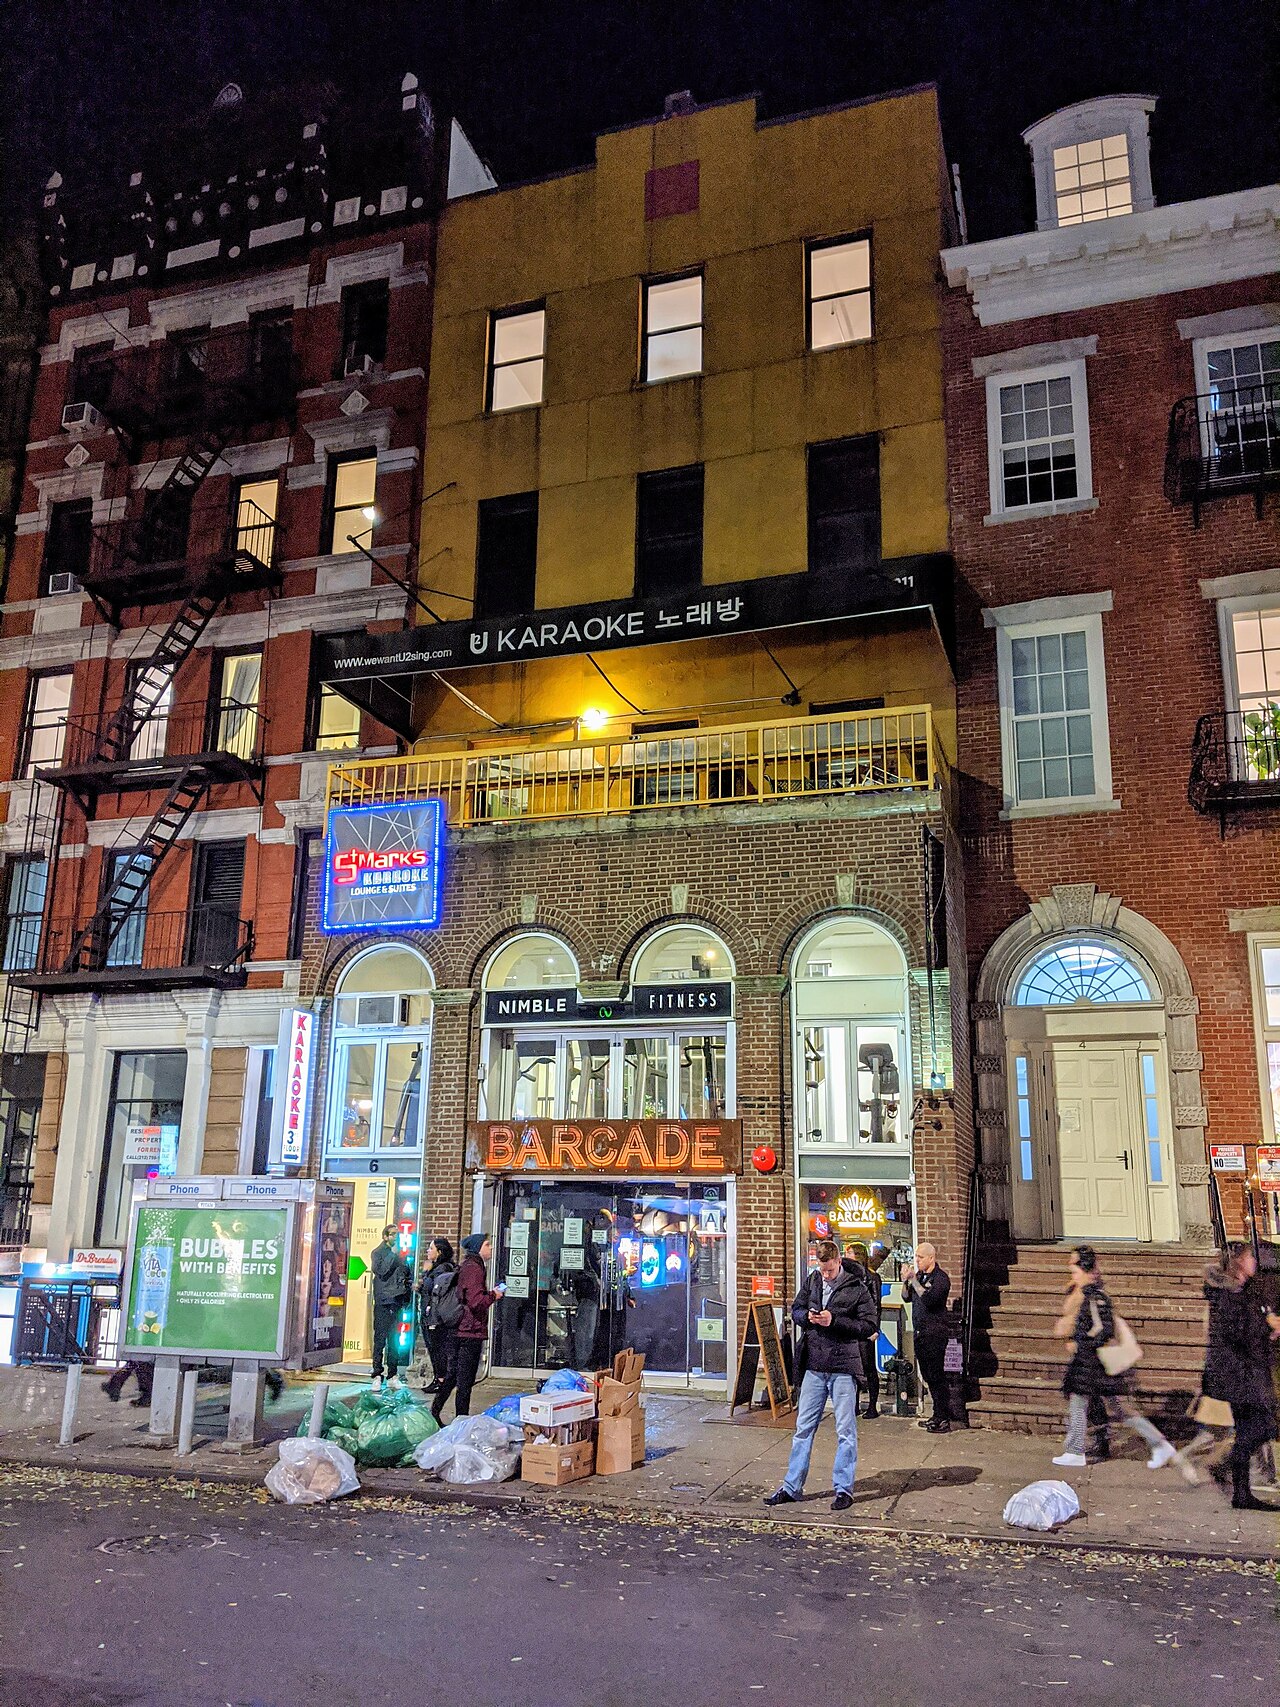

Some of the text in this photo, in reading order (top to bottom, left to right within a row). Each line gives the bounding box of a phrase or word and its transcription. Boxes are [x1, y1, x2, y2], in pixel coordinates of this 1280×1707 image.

[497, 611, 644, 652] KARAOKE
[655, 597, 744, 629] 노래방
[498, 992, 717, 1014] NIMBLE FITNESS
[1079, 1041, 1087, 1049] 4
[289, 1015, 308, 1129] KARAOKE
[485, 1124, 725, 1168] BARCADE
[369, 1159, 379, 1173] 6
[1213, 1158, 1224, 1168] NO
[169, 1185, 200, 1194] Phone
[245, 1185, 277, 1195] Phone
[325, 1185, 344, 1196] Phone
[704, 1212, 717, 1227] A
[829, 1210, 885, 1223] BARCADE
[179, 1261, 277, 1275] WITH BENEFITS
[237, 1292, 275, 1300] ELECTROLYTES
